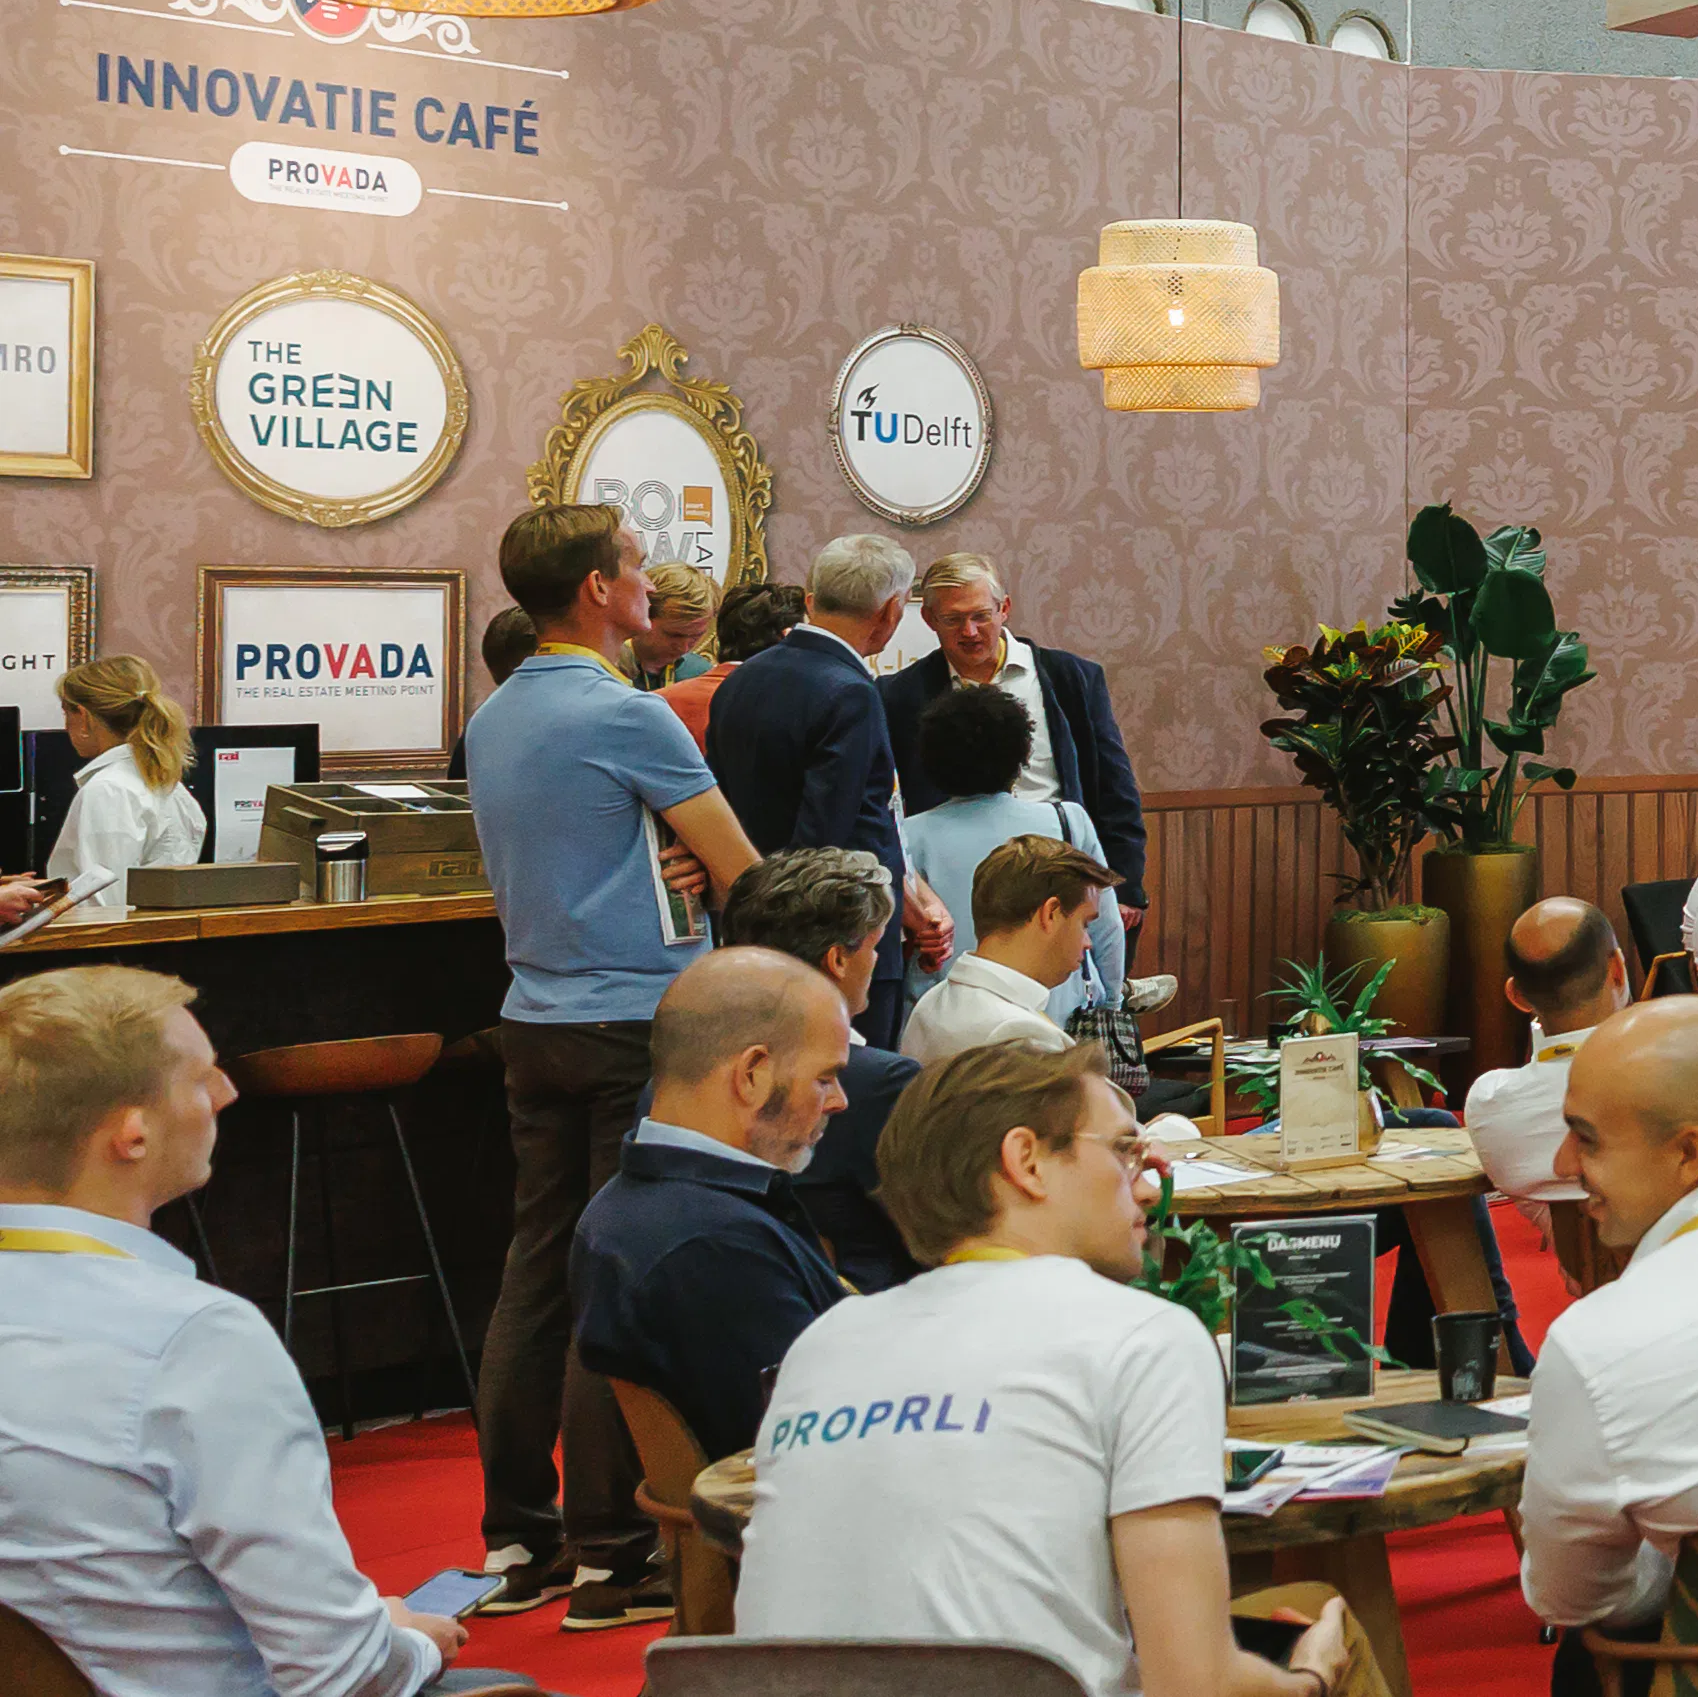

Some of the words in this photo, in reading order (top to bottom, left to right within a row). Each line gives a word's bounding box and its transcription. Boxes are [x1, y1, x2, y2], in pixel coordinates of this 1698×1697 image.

[96, 52, 397, 137] INNOVATIE
[415, 97, 540, 157] CAFÉ
[268, 158, 388, 193] PROVADA
[247, 340, 301, 364] THE
[248, 372, 392, 411] GREEN
[249, 414, 418, 453] VILLAGE
[851, 409, 898, 444] TU
[904, 414, 972, 449] Delft
[2, 654, 56, 670] GHT
[236, 643, 434, 680] PROVADA
[236, 687, 259, 698] THE
[264, 686, 295, 698] REAL
[299, 686, 341, 697] ESTATE
[345, 684, 396, 697] MEETING
[400, 684, 434, 695] POINT
[770, 1393, 991, 1455] PROPRLI
